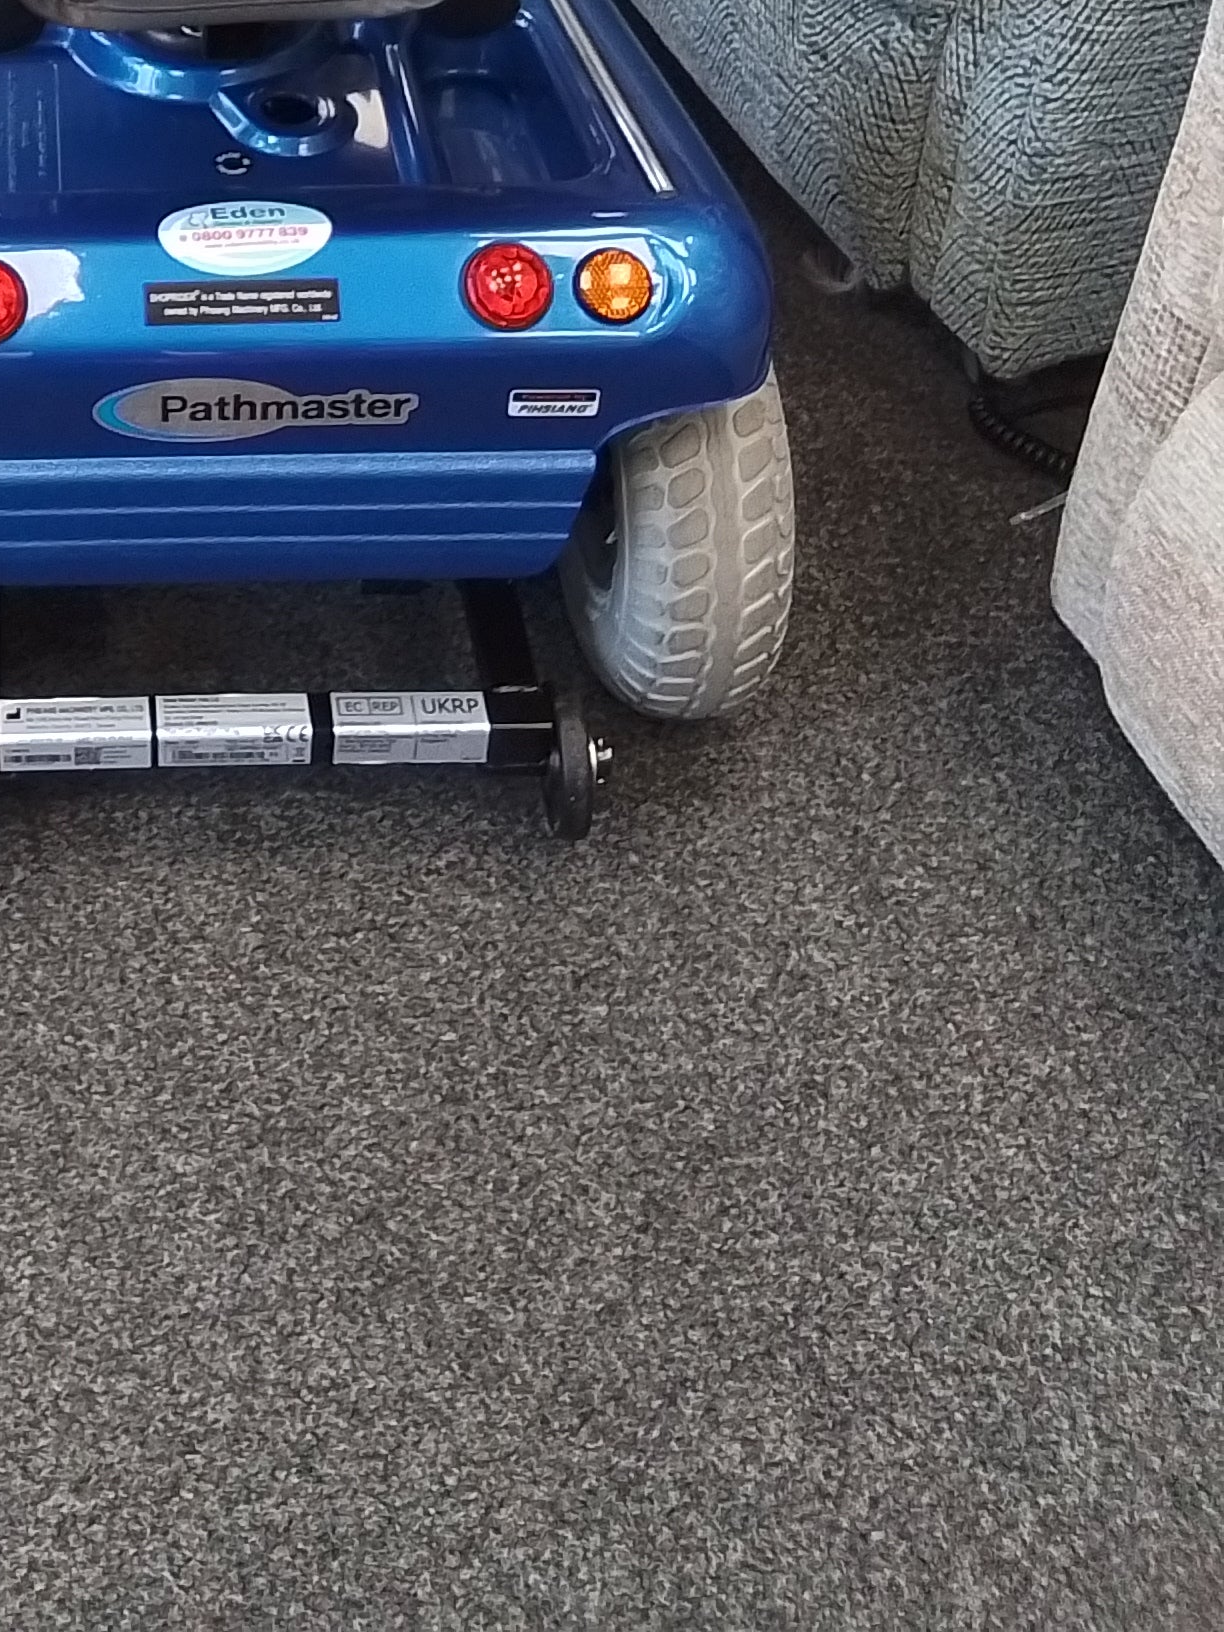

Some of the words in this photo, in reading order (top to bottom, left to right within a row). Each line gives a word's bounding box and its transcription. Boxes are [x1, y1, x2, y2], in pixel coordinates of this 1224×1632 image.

[210, 206, 286, 220] Eden
[191, 230, 233, 242] 0800
[236, 227, 275, 240] 9777
[278, 226, 309, 236] 839
[159, 393, 411, 423] Pathmaster
[344, 701, 363, 712] EC
[372, 700, 399, 711] REP
[421, 697, 479, 714] UKRP
